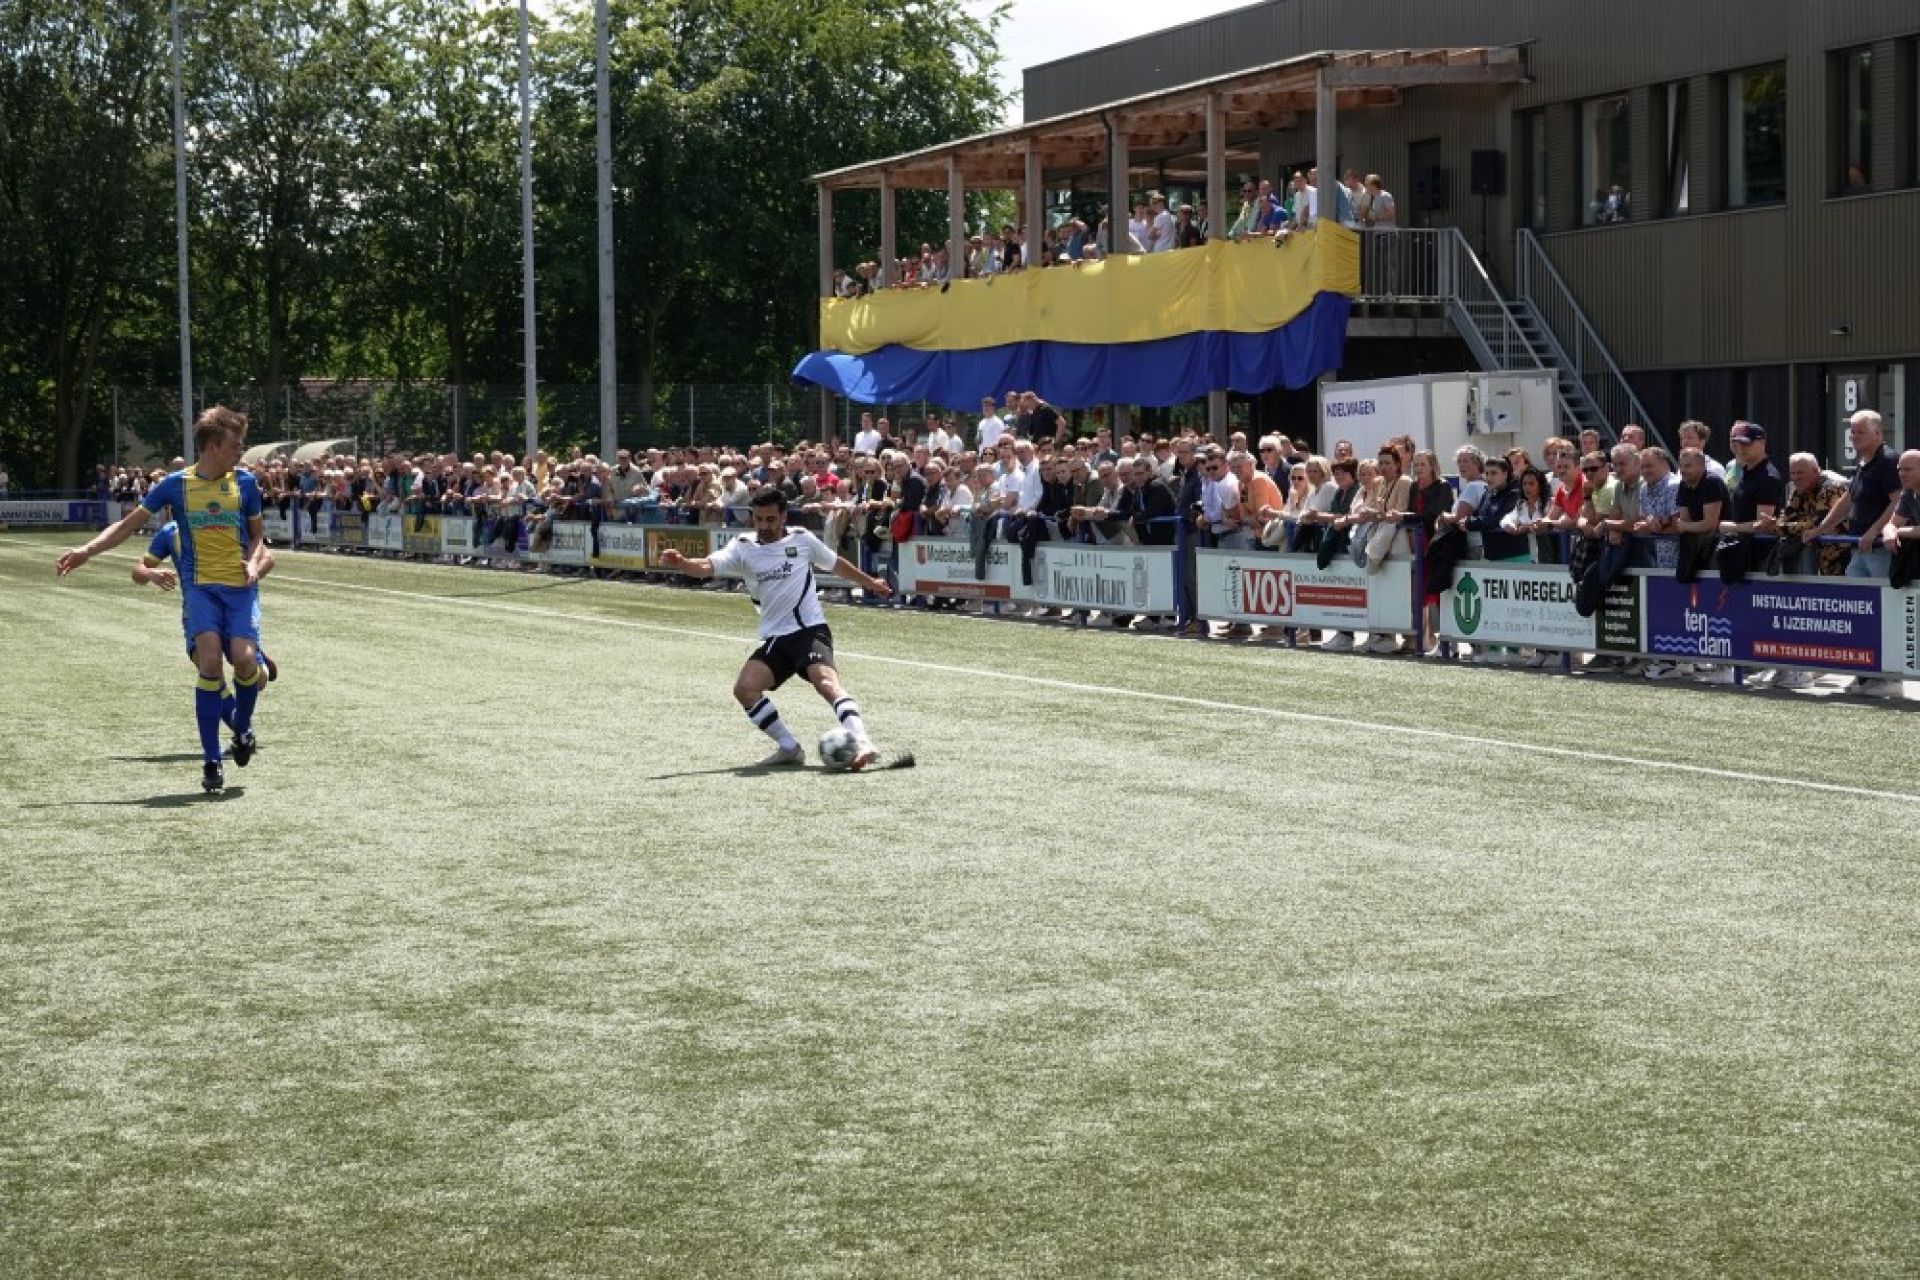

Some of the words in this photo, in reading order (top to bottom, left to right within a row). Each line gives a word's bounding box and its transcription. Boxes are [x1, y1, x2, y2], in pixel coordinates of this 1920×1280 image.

[1243, 570, 1291, 616] VOS
[1482, 578, 1509, 600] TEN
[1513, 579, 1577, 604] VREGELA
[1752, 594, 1874, 615] INSTALLATIETECHNIEK
[1684, 608, 1708, 633] ten
[1772, 615, 1781, 629] &
[1783, 615, 1852, 634] IJZERWAREN
[1905, 596, 1915, 670] ALBERGEN
[1698, 626, 1731, 656] dam
